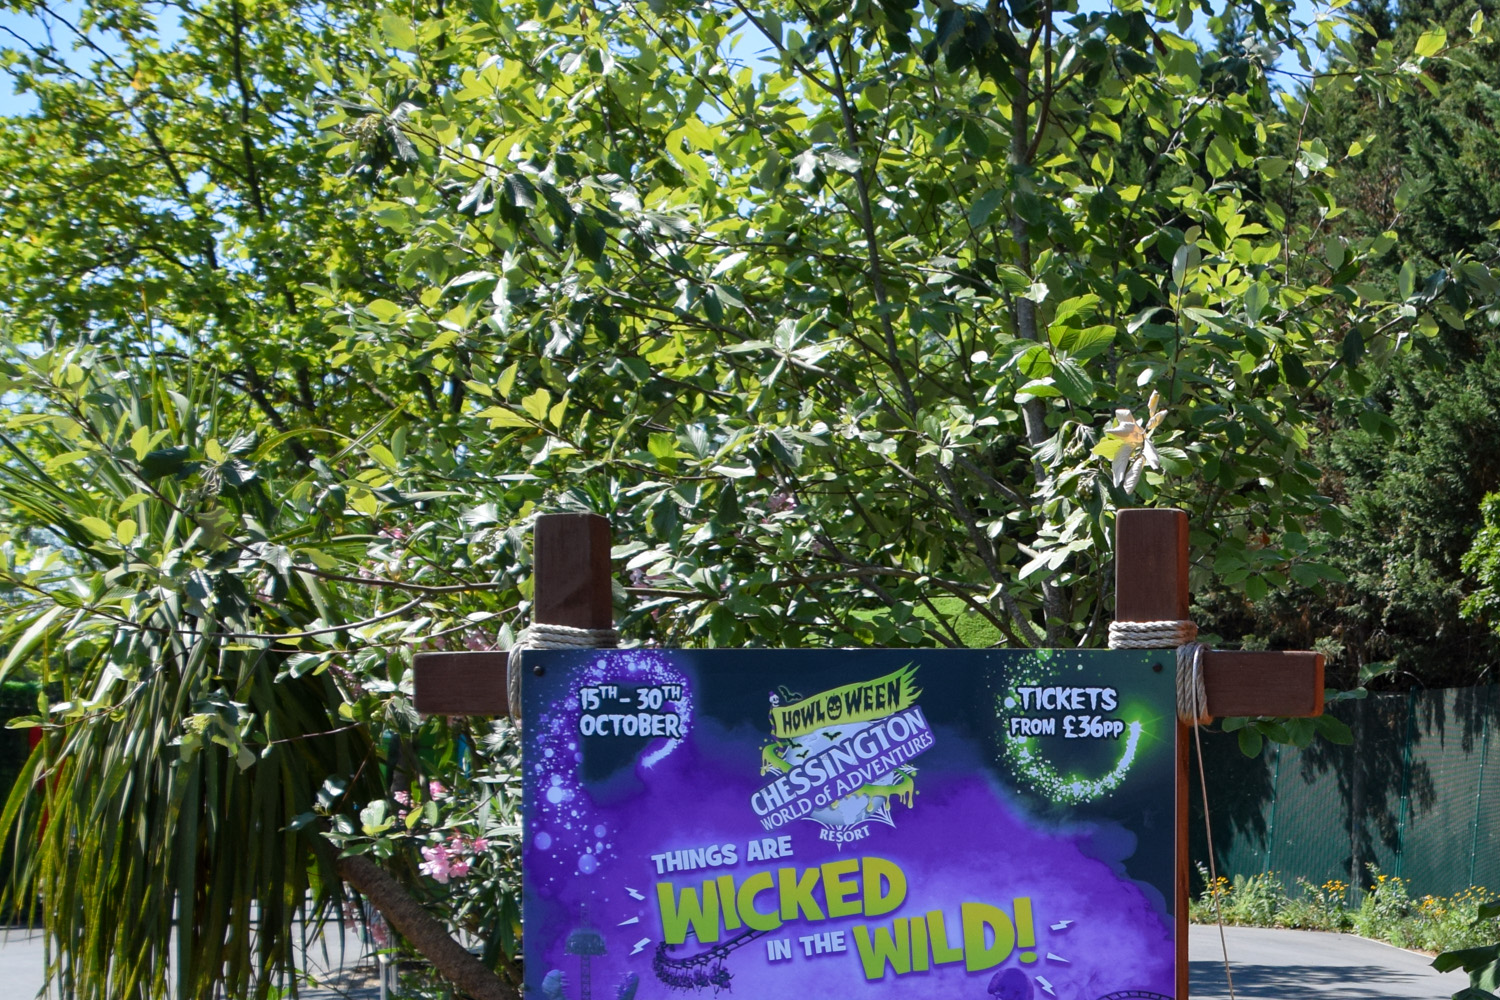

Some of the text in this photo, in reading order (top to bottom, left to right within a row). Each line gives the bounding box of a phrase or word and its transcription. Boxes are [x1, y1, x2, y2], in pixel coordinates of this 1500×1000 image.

[636, 685, 682, 710] 30TH
[1016, 686, 1117, 711] TICKETS
[579, 713, 682, 738] OCTOBER
[1010, 717, 1056, 736] FROM
[751, 708, 927, 816] CHESSINGTON
[760, 731, 933, 831] WORLD of ADVENTURES
[819, 825, 871, 843] RESORT
[651, 835, 794, 875] THINGS ARE
[656, 856, 908, 945] WICKED
[766, 896, 1038, 980] IN THE WILD!
